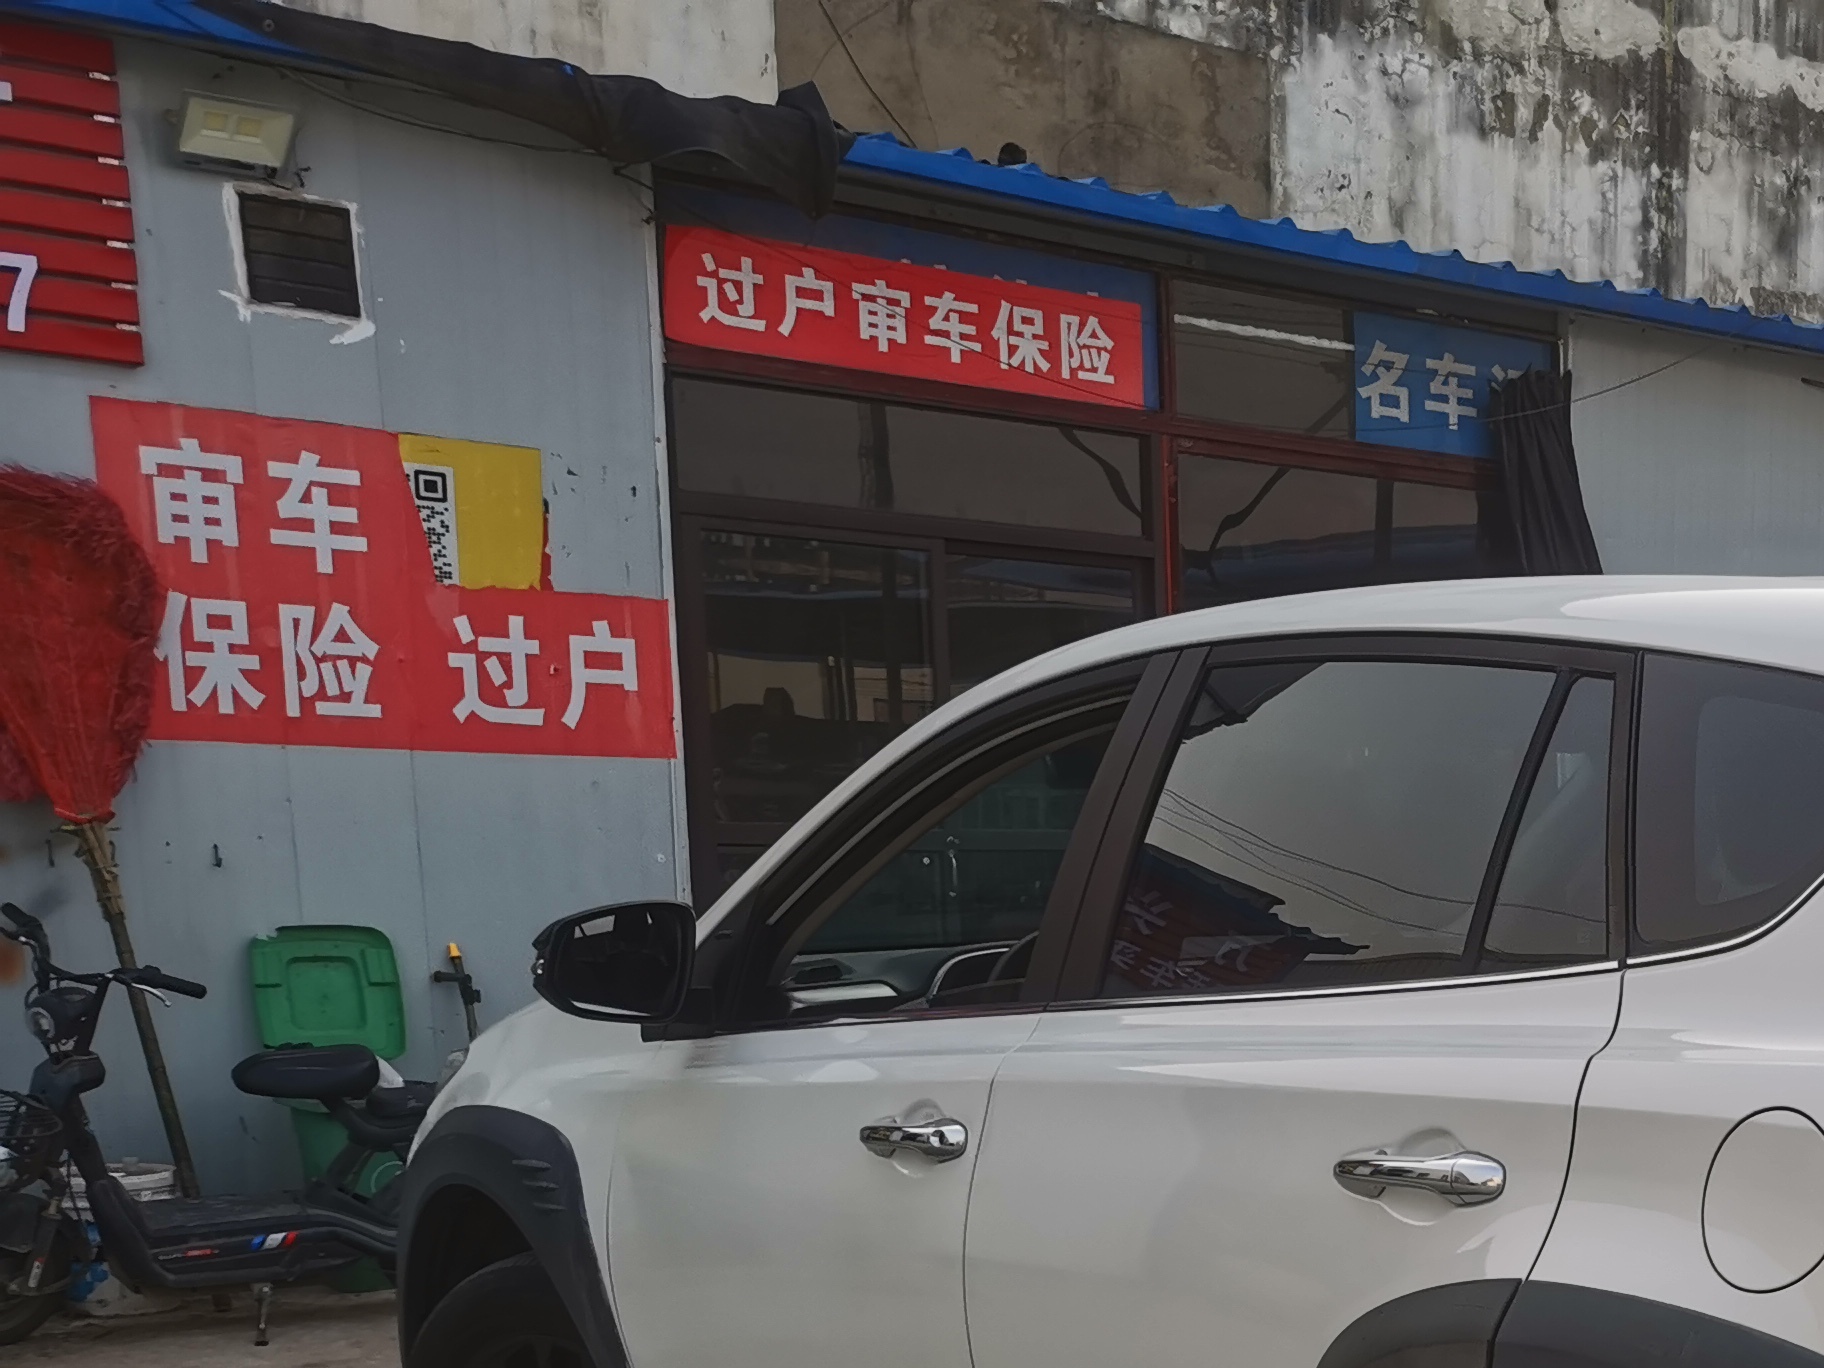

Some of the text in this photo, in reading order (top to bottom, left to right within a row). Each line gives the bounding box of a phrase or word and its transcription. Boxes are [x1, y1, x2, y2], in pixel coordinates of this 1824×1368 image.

[0, 252, 38, 332] 7
[695, 251, 1117, 387] 过户审车保险
[138, 437, 368, 574] 审车
[153, 589, 382, 719] 保险
[447, 615, 638, 731] 过户
